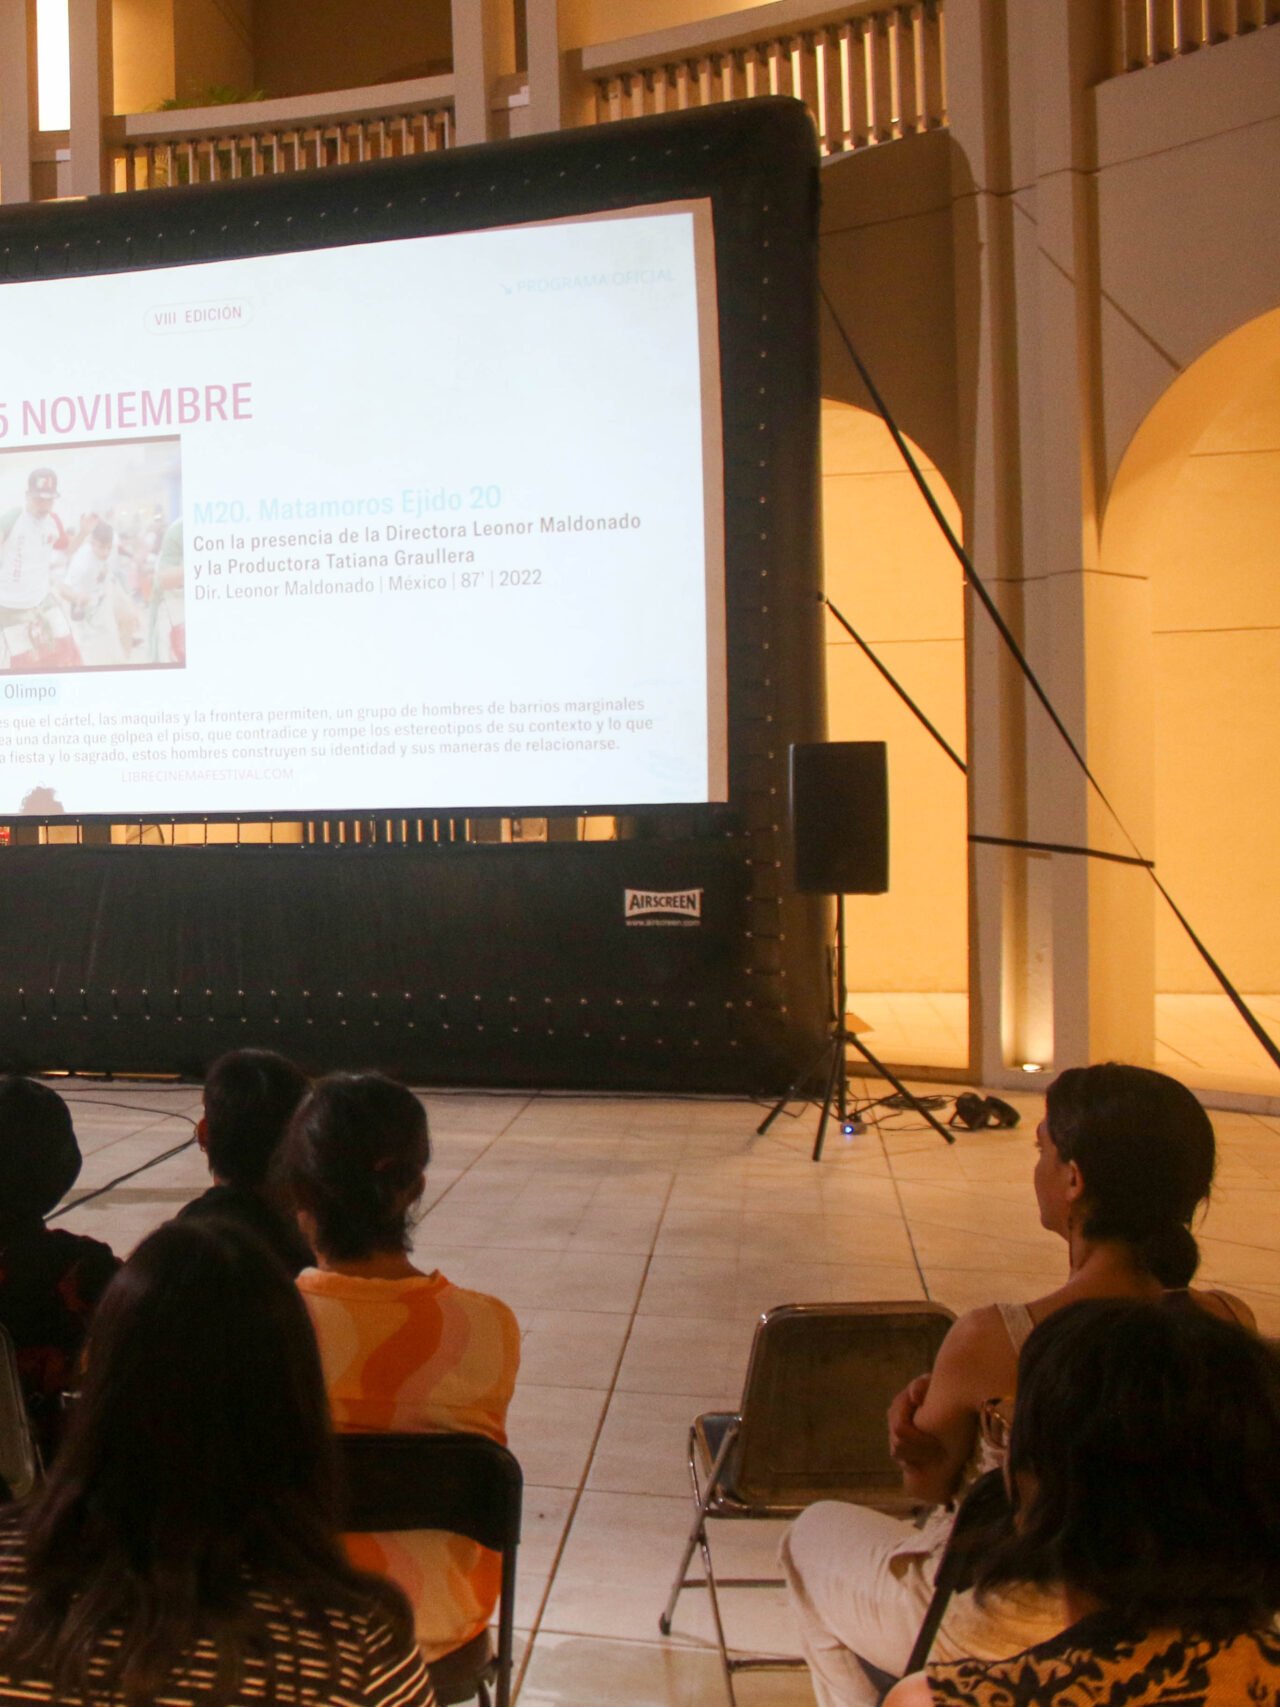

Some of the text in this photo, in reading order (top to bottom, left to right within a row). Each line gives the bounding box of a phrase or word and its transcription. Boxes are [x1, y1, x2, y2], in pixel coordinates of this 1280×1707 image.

[516, 268, 676, 293] PROGRAMA OFICIAL
[154, 305, 242, 326] VIII EDICIÓN
[22, 382, 253, 436] NOVIEMBRE
[193, 484, 502, 525] M20. Matamoros Ejido 20
[193, 513, 641, 552] Con la presencia de la Directora Leonor Maldonado
[194, 547, 475, 580] y la Productora Tatiana Graullera
[195, 584, 221, 600] Dir.
[226, 583, 280, 599] Leonor
[284, 577, 375, 597] Maldonado
[499, 569, 543, 586] 2022
[4, 683, 57, 701] Olimpo
[13, 717, 36, 730] que
[39, 714, 51, 727] el
[99, 712, 118, 726] las
[121, 711, 181, 727] maquilas
[183, 713, 191, 726] y
[194, 710, 206, 723] la
[210, 709, 263, 723] frontera
[267, 706, 332, 723] permiten,
[336, 707, 353, 719] un
[357, 706, 397, 721] grupo
[401, 704, 417, 717] de
[422, 701, 484, 717] hombres
[487, 700, 505, 715] de
[509, 699, 560, 714] barrios
[564, 696, 645, 715] marginales
[16, 735, 39, 746] una
[42, 731, 79, 745] danza
[83, 732, 107, 747] que
[110, 730, 153, 746] golpea
[157, 729, 169, 742] el
[172, 728, 204, 744] piso,
[207, 729, 232, 743] que
[235, 725, 308, 740] contradice
[311, 728, 319, 741] y
[323, 726, 366, 740] rompe
[370, 723, 391, 737] los
[394, 721, 482, 737] estereotipos
[486, 719, 504, 733] de
[508, 721, 525, 733] su
[528, 719, 592, 733] contexto
[595, 720, 604, 734] y
[608, 716, 621, 731] lo
[625, 717, 654, 733] que
[10, 749, 45, 764] fiesta
[48, 752, 56, 765] y
[59, 750, 70, 762] lo
[74, 748, 129, 765] sagrado,
[132, 749, 167, 761] estos
[170, 746, 228, 760] hombres
[232, 746, 307, 760] construyen
[311, 745, 326, 757] su
[330, 741, 395, 757] identidad
[400, 744, 407, 758] y
[411, 742, 436, 755] sus
[439, 740, 500, 754] maneras
[504, 738, 521, 753] de
[525, 737, 620, 752] relacionarse.
[628, 893, 697, 911] AIRSCREEN
